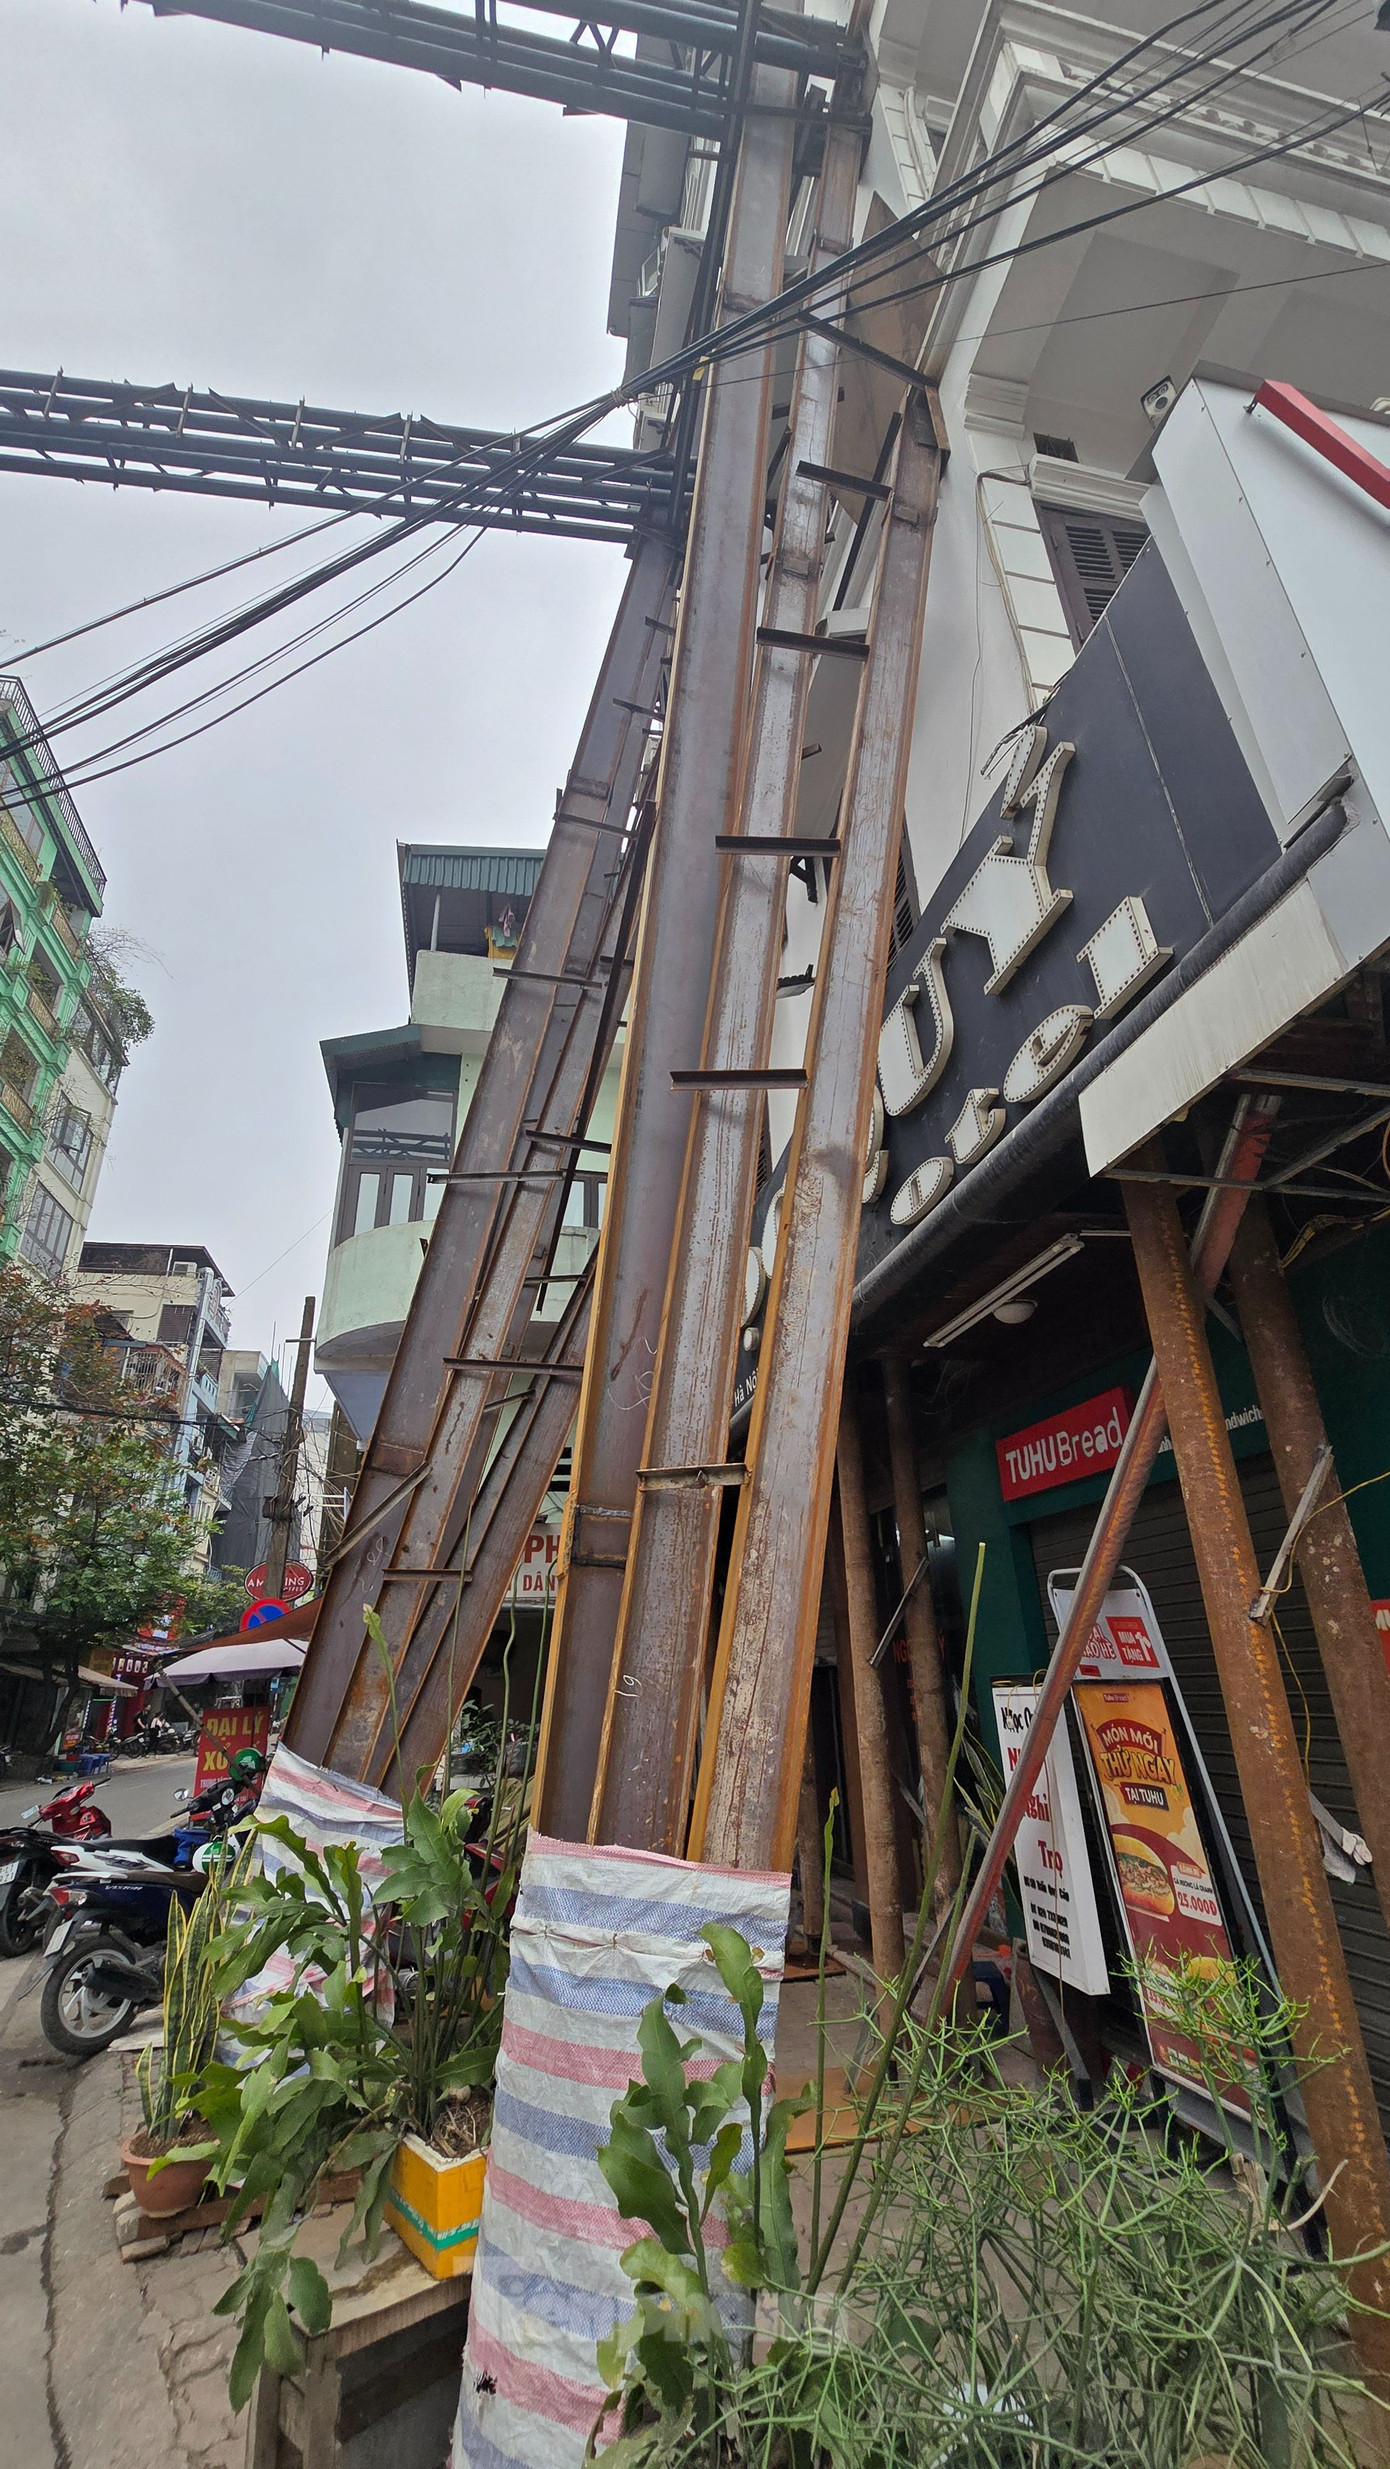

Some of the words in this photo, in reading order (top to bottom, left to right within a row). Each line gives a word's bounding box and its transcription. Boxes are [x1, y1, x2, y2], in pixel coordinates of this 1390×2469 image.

[1224, 1404, 1262, 1431] ndwich
[247, 1576, 305, 1588] AMING
[1101, 1723, 1129, 1747] MÓN
[1131, 1729, 1158, 1755] MỚI
[1100, 1744, 1132, 1778] THỬ
[1131, 1752, 1177, 1786] NGAY
[1140, 1788, 1164, 1806] TUHU
